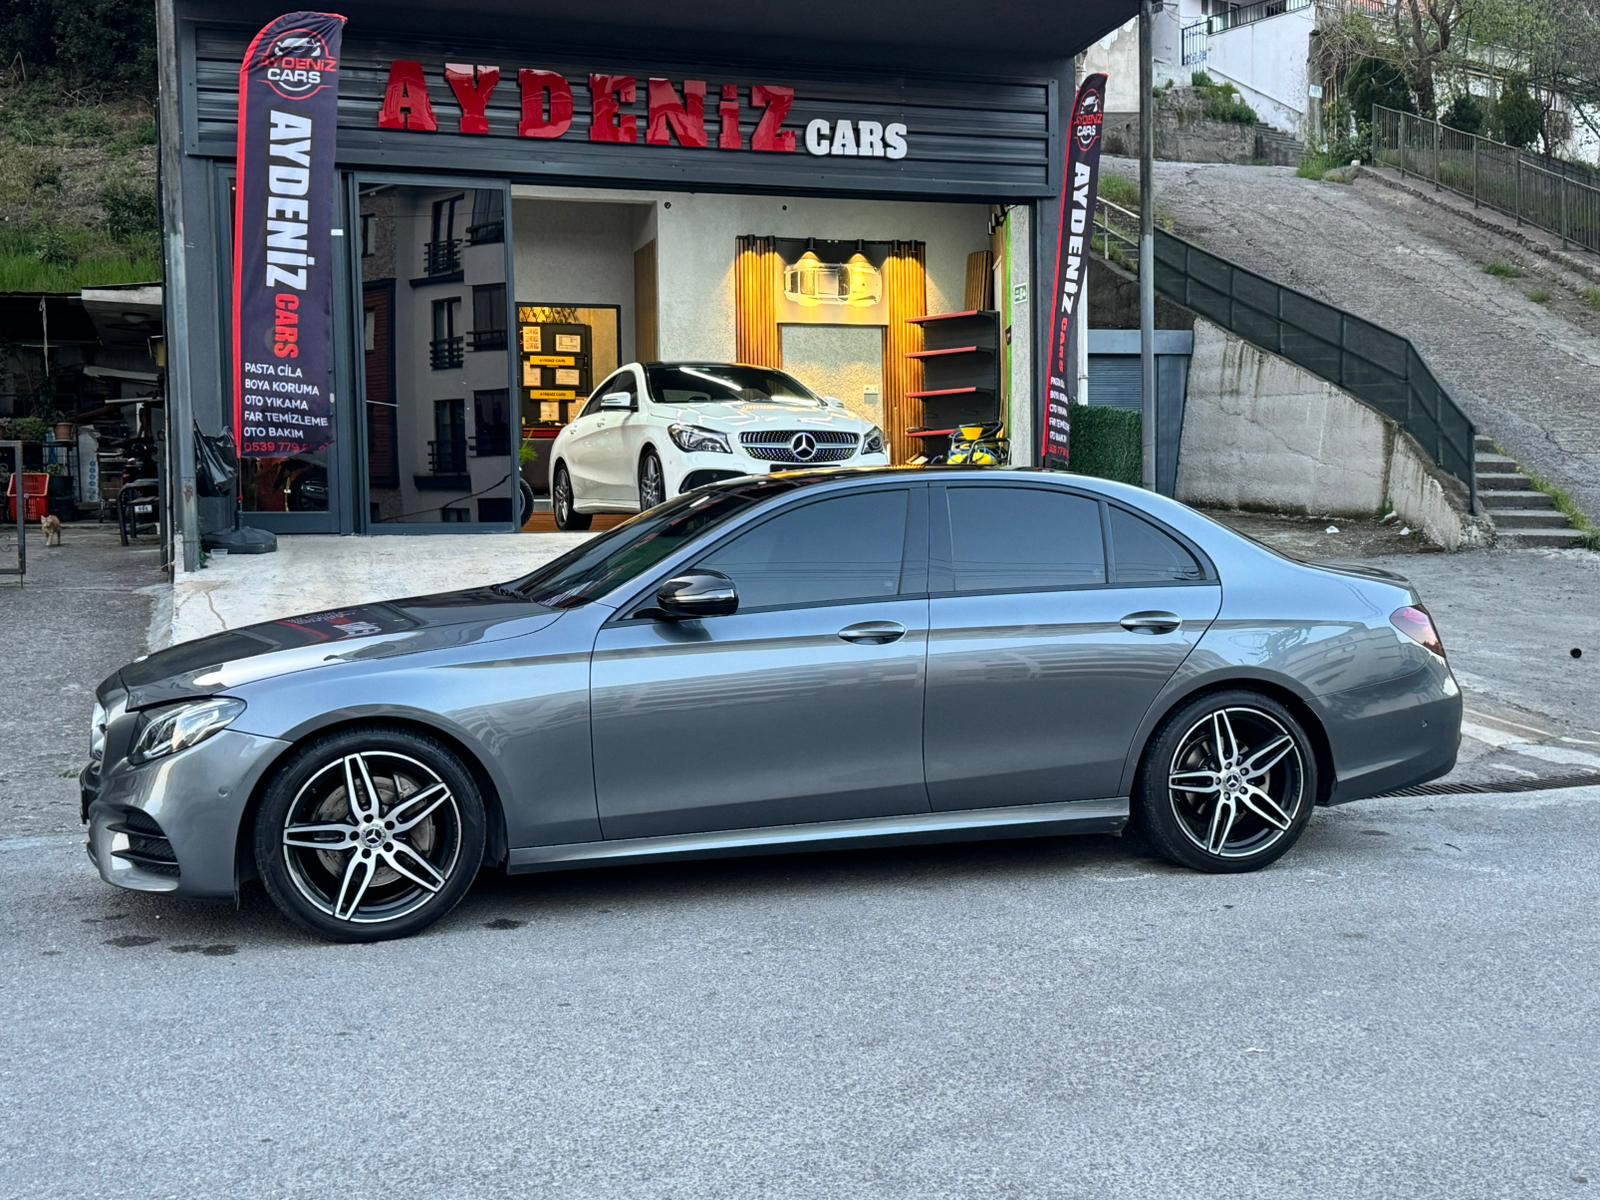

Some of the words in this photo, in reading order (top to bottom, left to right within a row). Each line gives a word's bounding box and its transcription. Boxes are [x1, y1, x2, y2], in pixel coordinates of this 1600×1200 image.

[267, 68, 321, 84] CARS
[1076, 124, 1097, 137] CARS
[805, 118, 908, 160] CARS
[273, 293, 300, 359] CARS
[245, 362, 275, 375] PASTA
[277, 363, 303, 378] CİLA
[244, 378, 270, 391] BOYA
[272, 381, 320, 396] KORUMA
[244, 394, 264, 406] OTO
[265, 396, 309, 411] YIKAMA
[244, 410, 263, 422] FAR
[264, 411, 329, 427] TEMİZLEME
[243, 426, 266, 437] OTO
[268, 427, 304, 439] BAKIM
[244, 441, 275, 452] 0539
